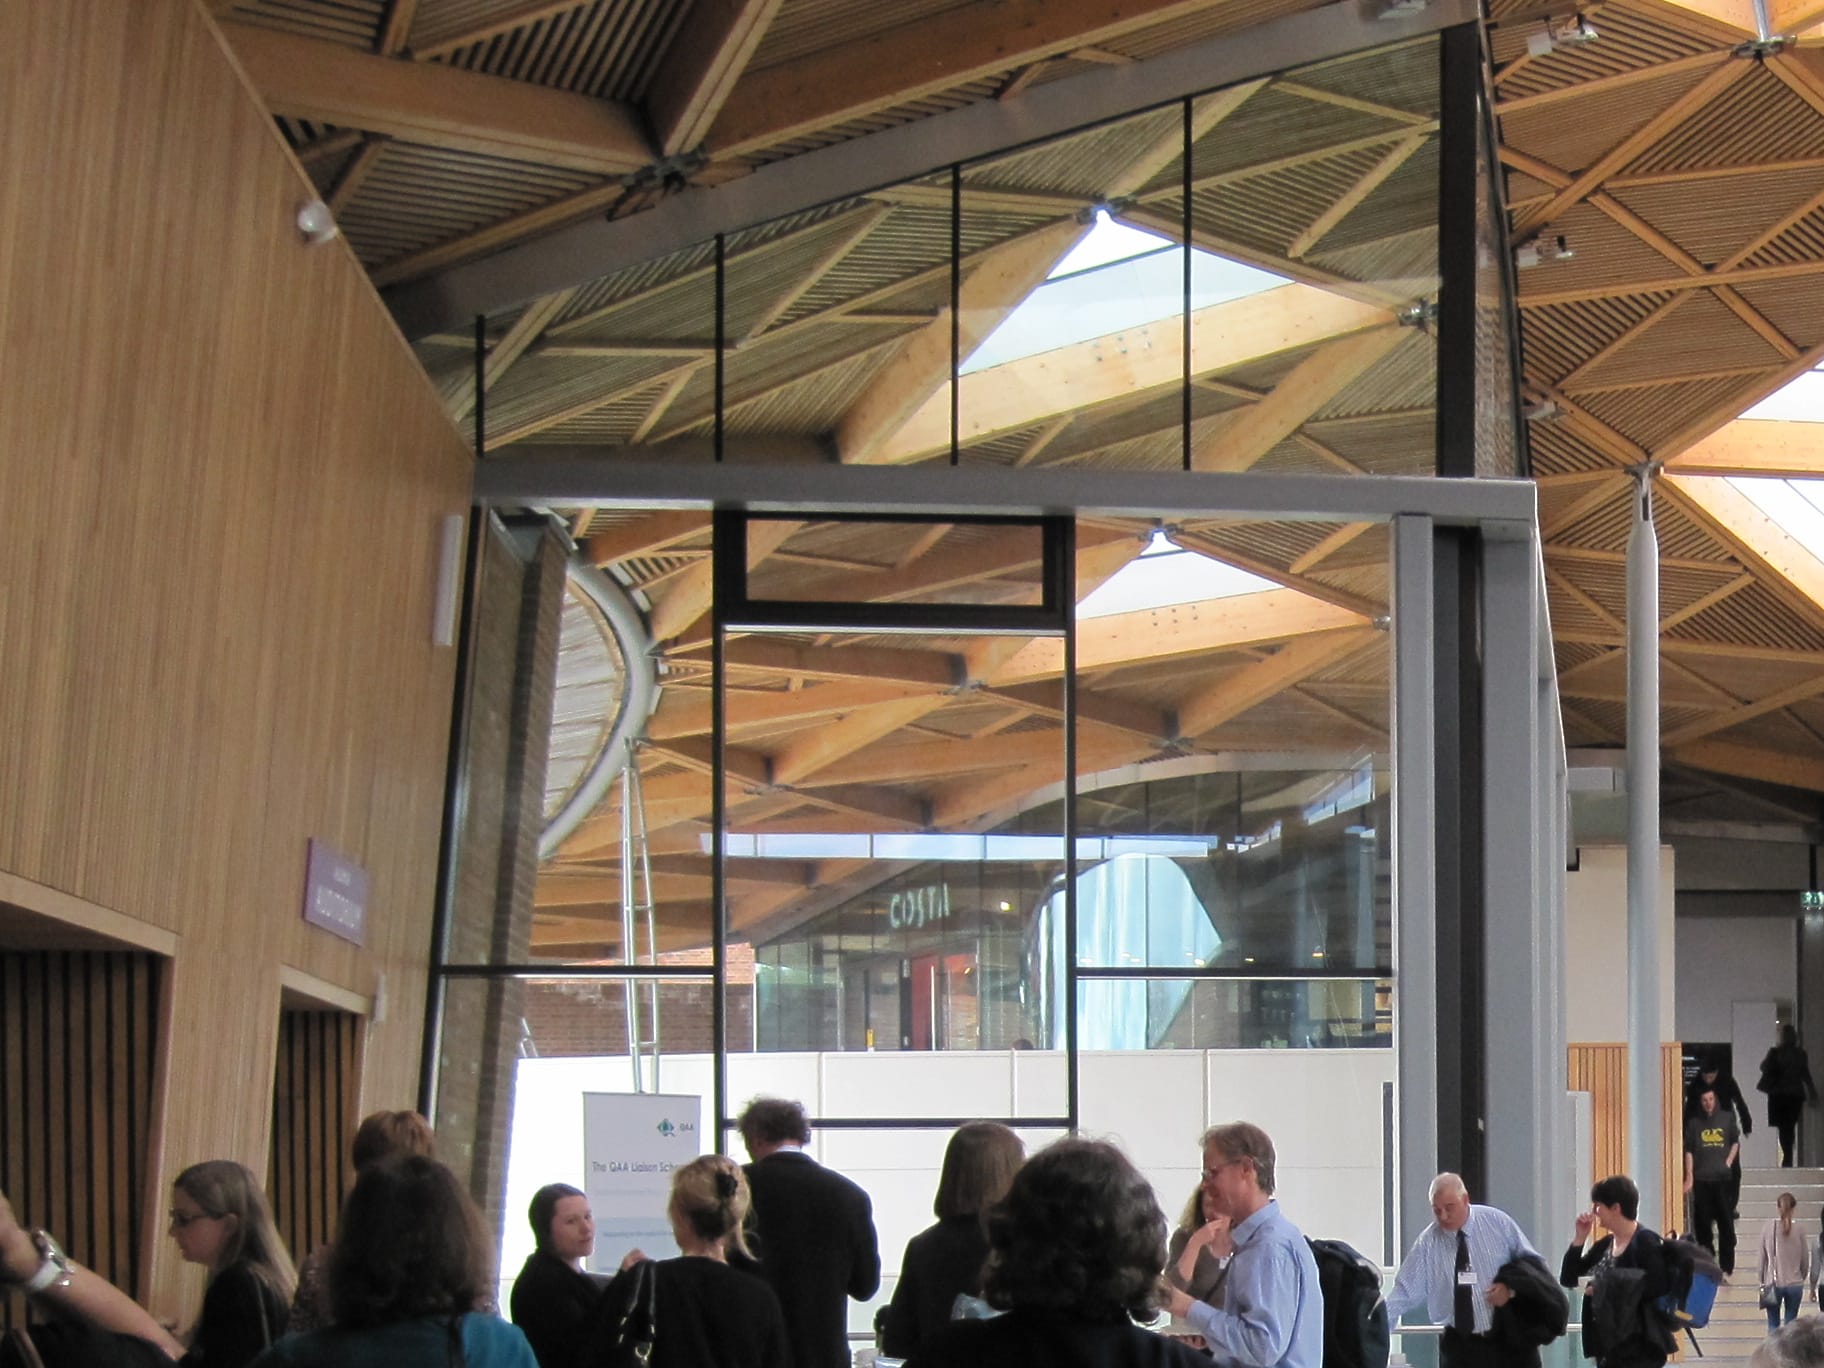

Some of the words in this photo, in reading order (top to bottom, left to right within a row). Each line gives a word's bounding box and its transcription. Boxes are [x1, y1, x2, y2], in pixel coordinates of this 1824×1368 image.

[592, 1160, 607, 1173] The
[609, 1160, 629, 1173] QAA
[631, 1160, 658, 1173] Liaison
